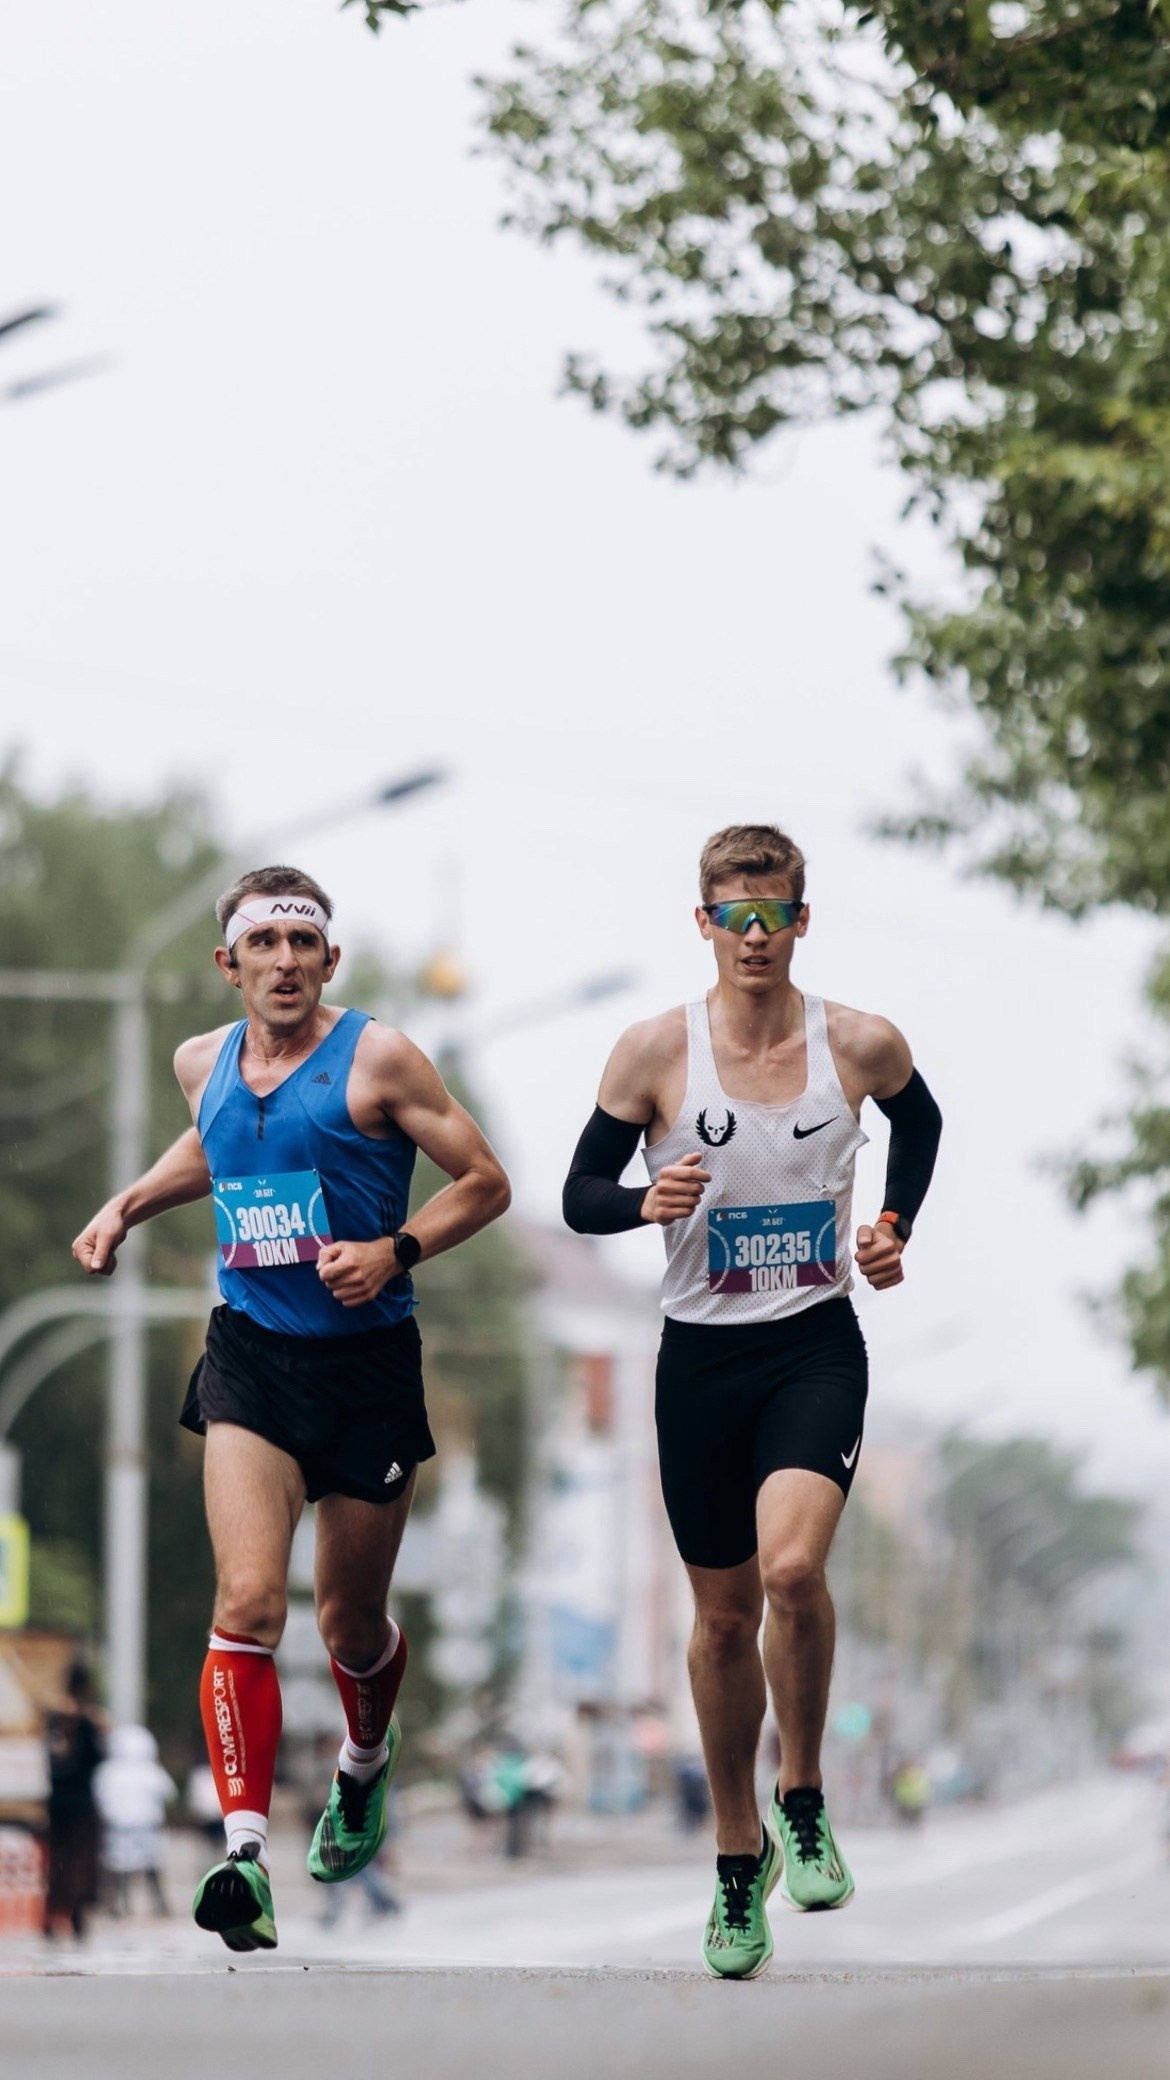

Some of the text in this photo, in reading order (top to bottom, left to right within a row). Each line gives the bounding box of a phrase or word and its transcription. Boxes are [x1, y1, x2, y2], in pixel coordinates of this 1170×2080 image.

[236, 1203, 306, 1241] 30034
[252, 1237, 300, 1267] 10KM
[735, 1231, 811, 1267] 30235
[748, 1264, 798, 1292] 10KM
